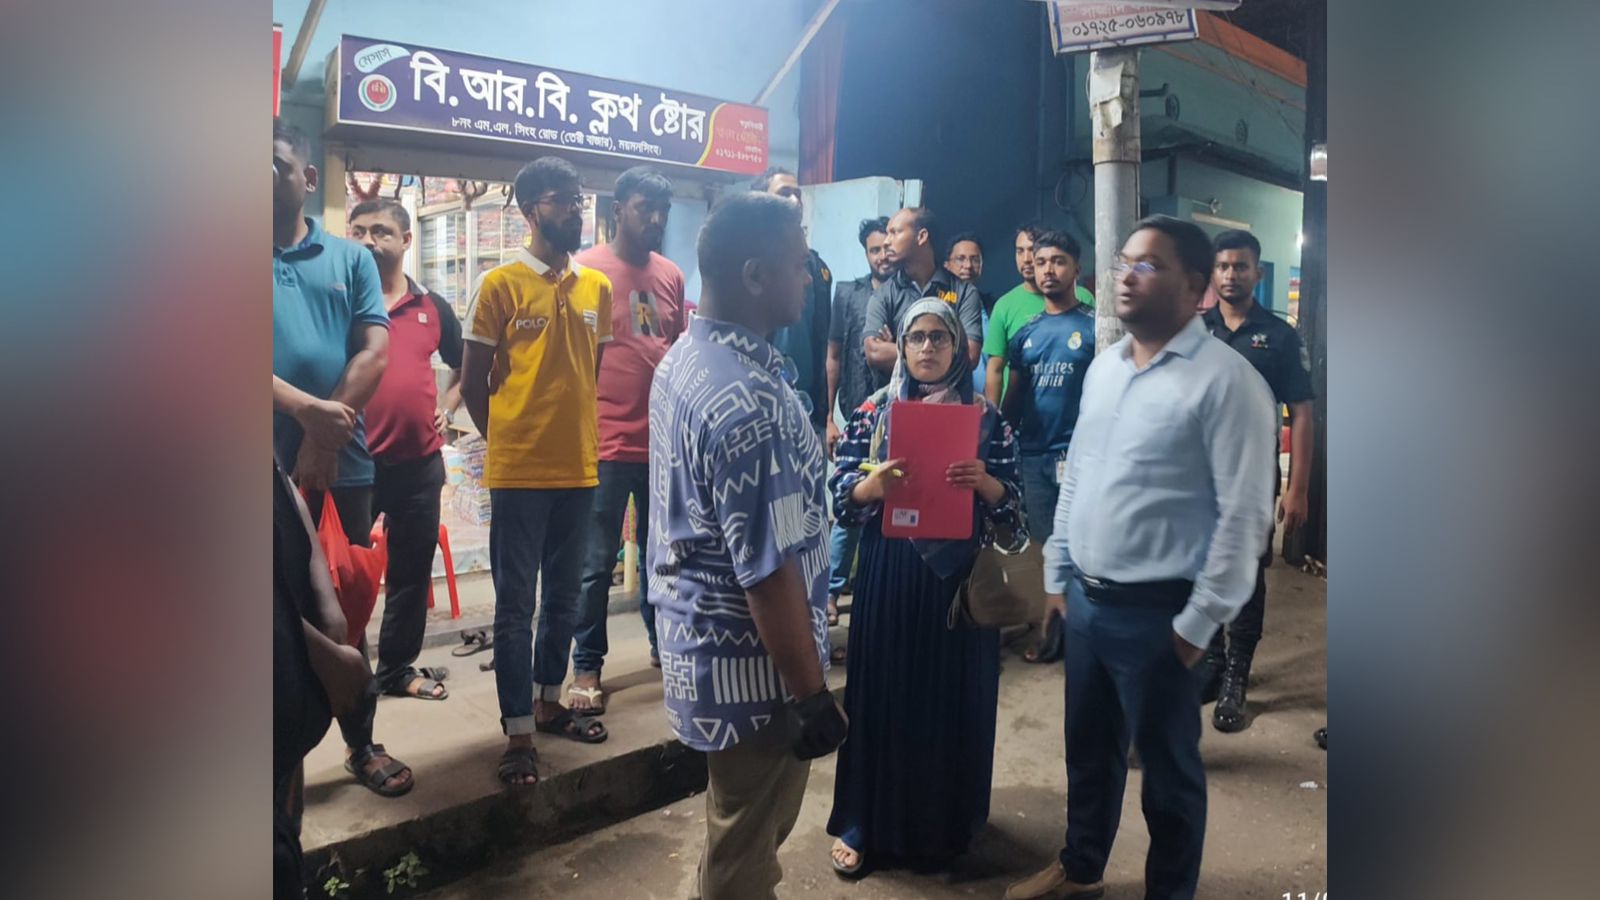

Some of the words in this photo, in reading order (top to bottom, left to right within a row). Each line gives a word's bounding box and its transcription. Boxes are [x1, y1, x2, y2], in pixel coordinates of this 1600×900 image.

[588, 89, 643, 135] ক্লথ
[650, 92, 706, 143] ষ্টোর
[515, 317, 548, 331] POLO
